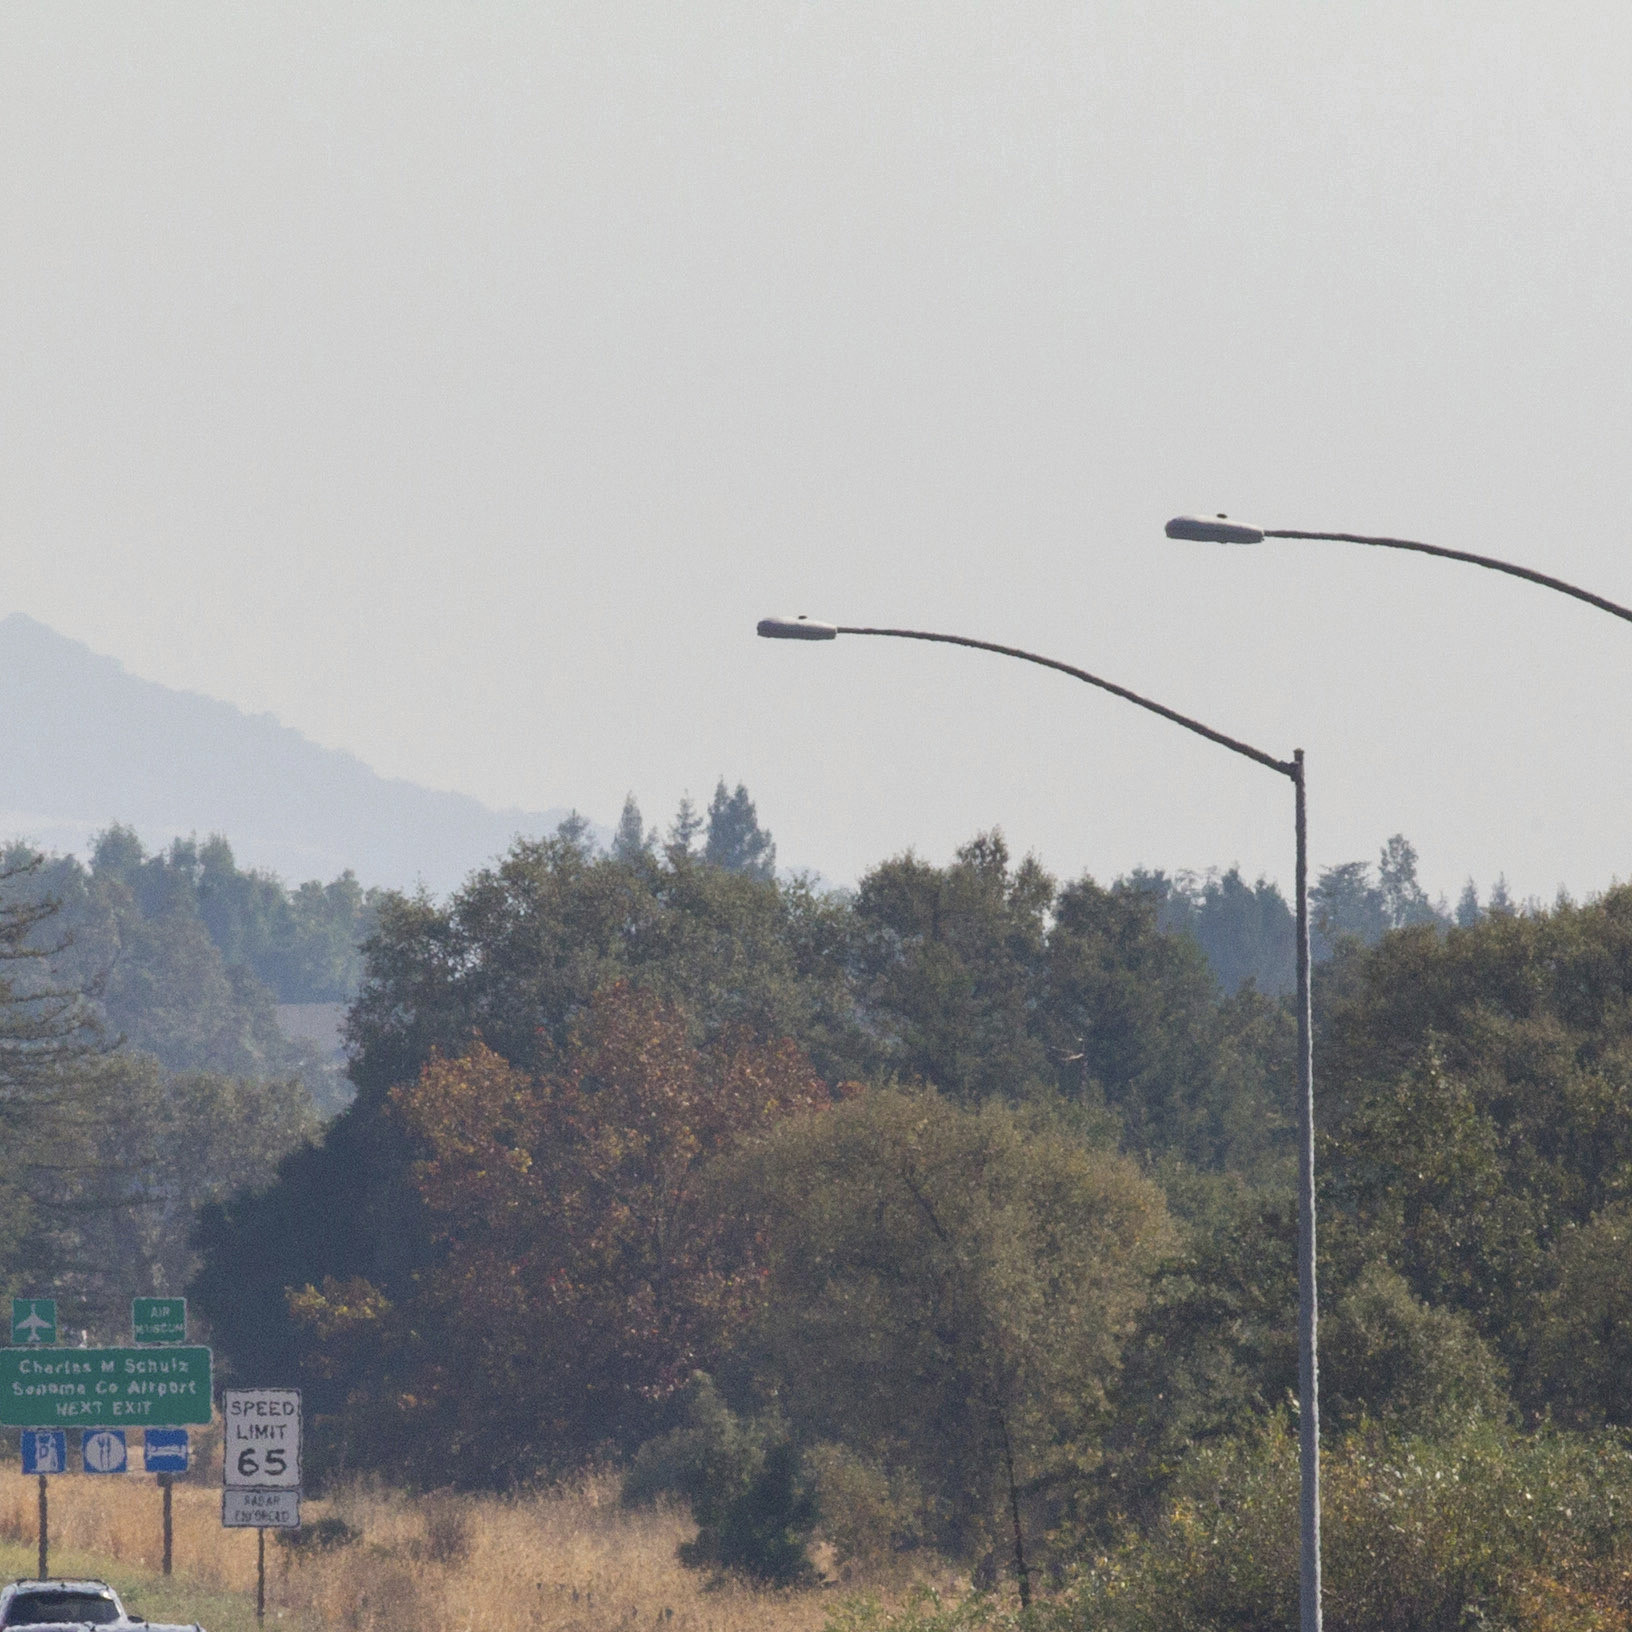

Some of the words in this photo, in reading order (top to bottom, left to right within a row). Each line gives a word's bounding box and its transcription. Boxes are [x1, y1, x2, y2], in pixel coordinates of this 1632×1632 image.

[150, 1306, 170, 1319] AIR
[18, 1359, 92, 1375] Charles
[101, 1360, 115, 1373] M
[124, 1357, 189, 1374] Schulz
[12, 1380, 86, 1396] Sonoma
[95, 1380, 118, 1395] Co
[127, 1380, 196, 1397] Airport
[56, 1401, 103, 1416] NEXT
[113, 1401, 152, 1416] EXIT
[231, 1401, 294, 1416] SPEED
[236, 1424, 287, 1440] LIMIT
[238, 1448, 287, 1476] 65
